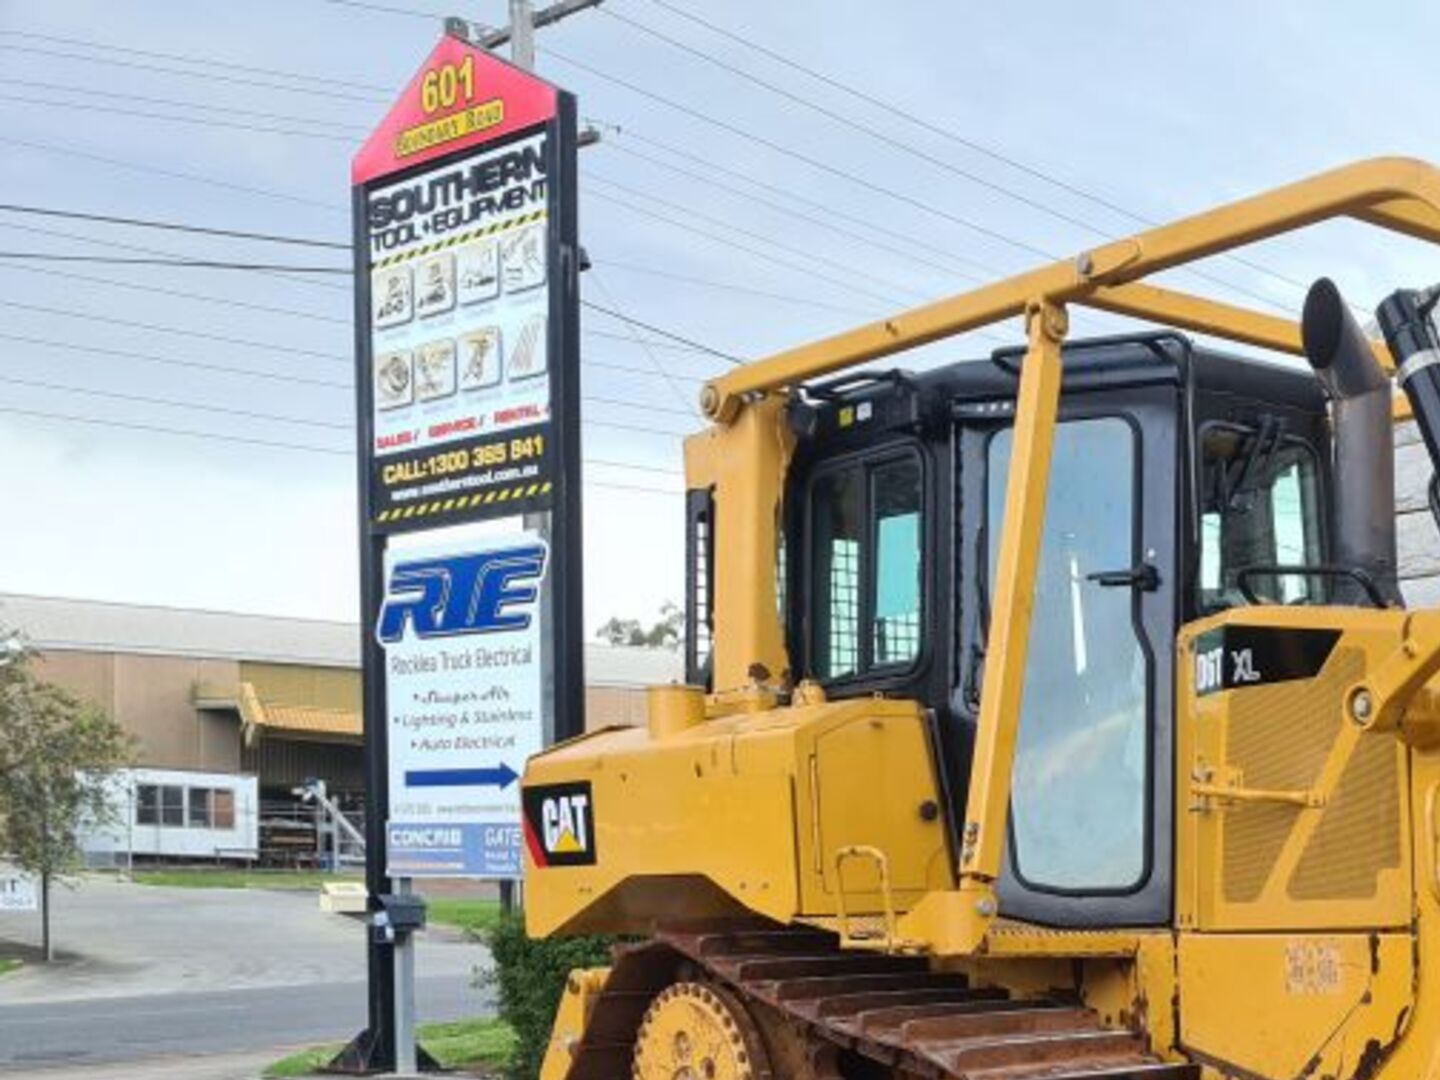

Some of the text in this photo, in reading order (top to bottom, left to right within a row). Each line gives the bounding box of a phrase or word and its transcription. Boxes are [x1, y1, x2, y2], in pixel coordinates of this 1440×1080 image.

[422, 57, 473, 112] 601
[369, 143, 547, 229] SOUTHERN
[378, 545, 547, 643] RTE
[440, 650, 473, 670] Truck
[476, 643, 532, 668] Electrical
[1232, 648, 1261, 682] XL
[403, 712, 457, 729] Lighting
[460, 711, 470, 724] &
[417, 734, 516, 751] Auto Electrical
[543, 794, 588, 854] CAT
